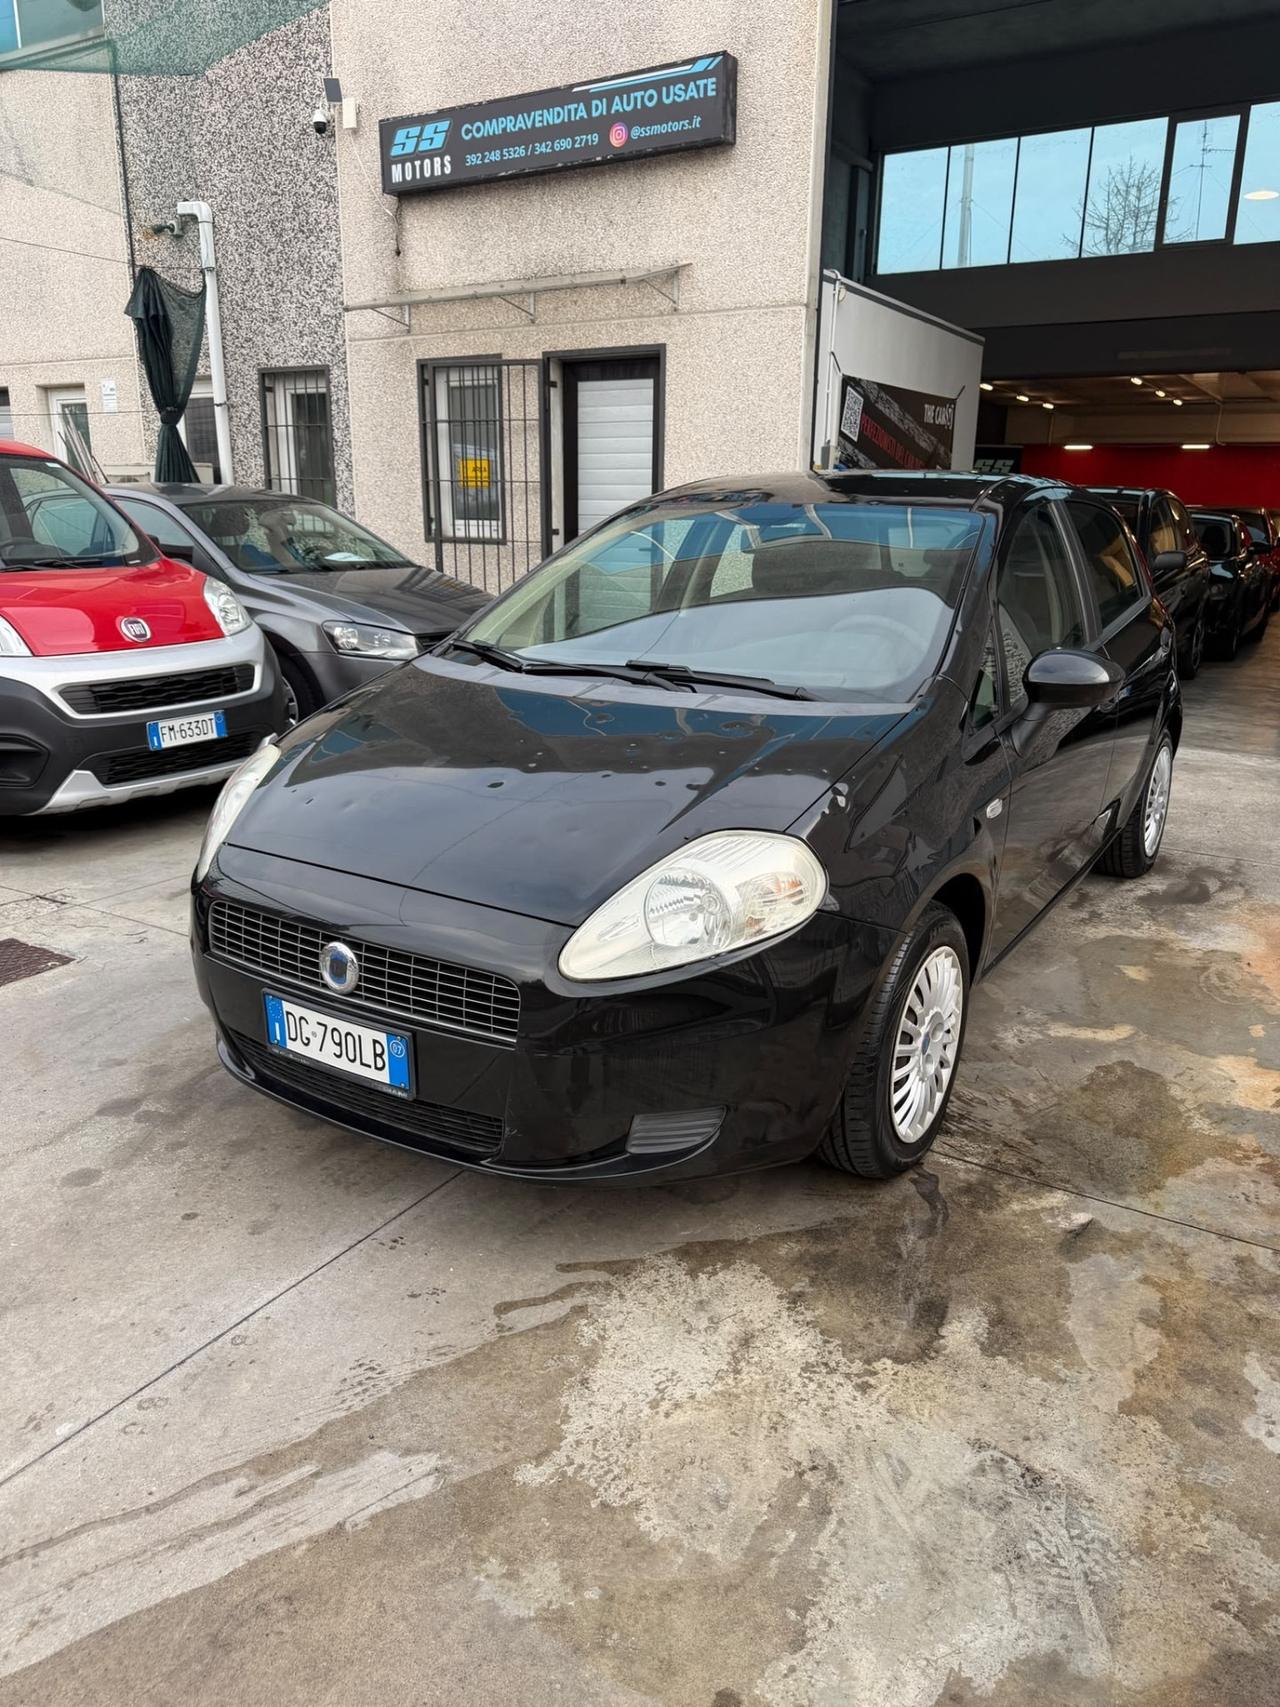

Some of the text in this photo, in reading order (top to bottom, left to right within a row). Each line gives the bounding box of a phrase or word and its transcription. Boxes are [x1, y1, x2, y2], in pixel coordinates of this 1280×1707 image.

[461, 77, 717, 141] COMPRAVENDITA DI AUTO USATE
[390, 120, 451, 157] SS
[630, 115, 702, 140] @ssmotors.it
[465, 133, 599, 166] 392 248 5326 / 342 690 2719
[391, 155, 452, 183] MOTORS
